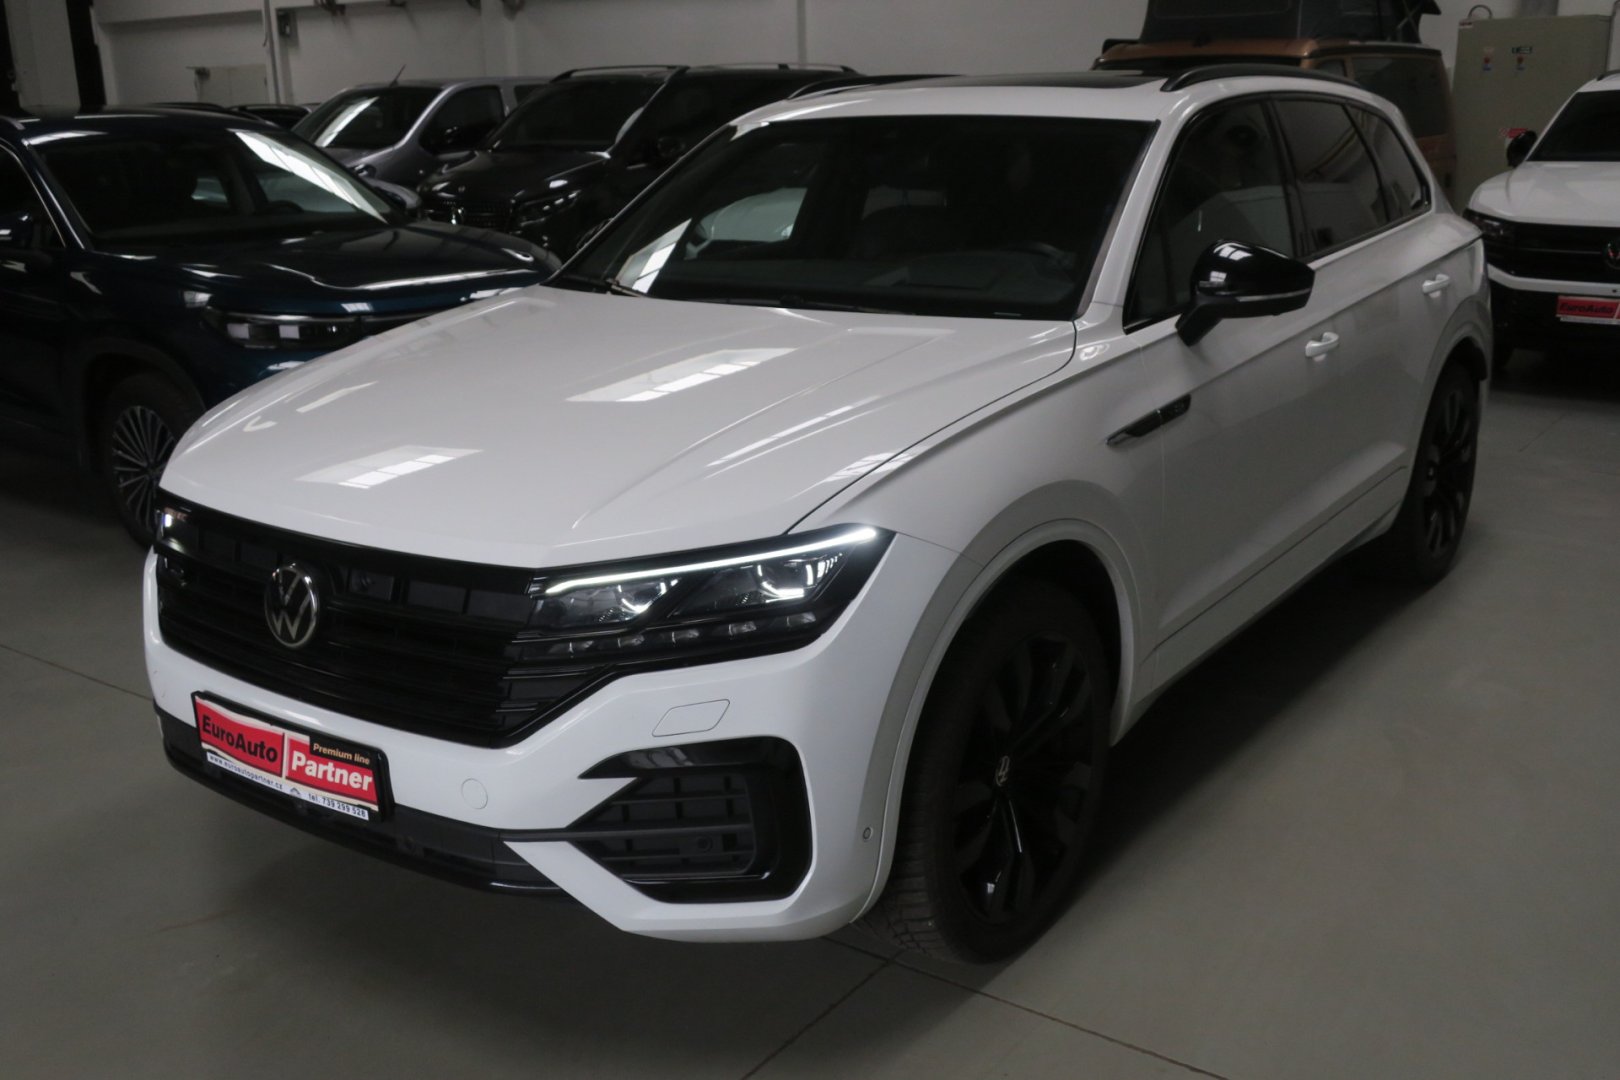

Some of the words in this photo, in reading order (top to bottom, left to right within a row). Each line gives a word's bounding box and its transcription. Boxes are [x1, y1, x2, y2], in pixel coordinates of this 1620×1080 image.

[202, 714, 278, 762] EuroAuto
[313, 743, 353, 761] Premium
[354, 752, 370, 765] line
[209, 755, 283, 790] www.euroautopartner.cz
[292, 750, 373, 792] Partner
[308, 793, 321, 803] tel.
[322, 797, 336, 808] 739
[337, 802, 351, 813] 299
[352, 807, 366, 818] 528
